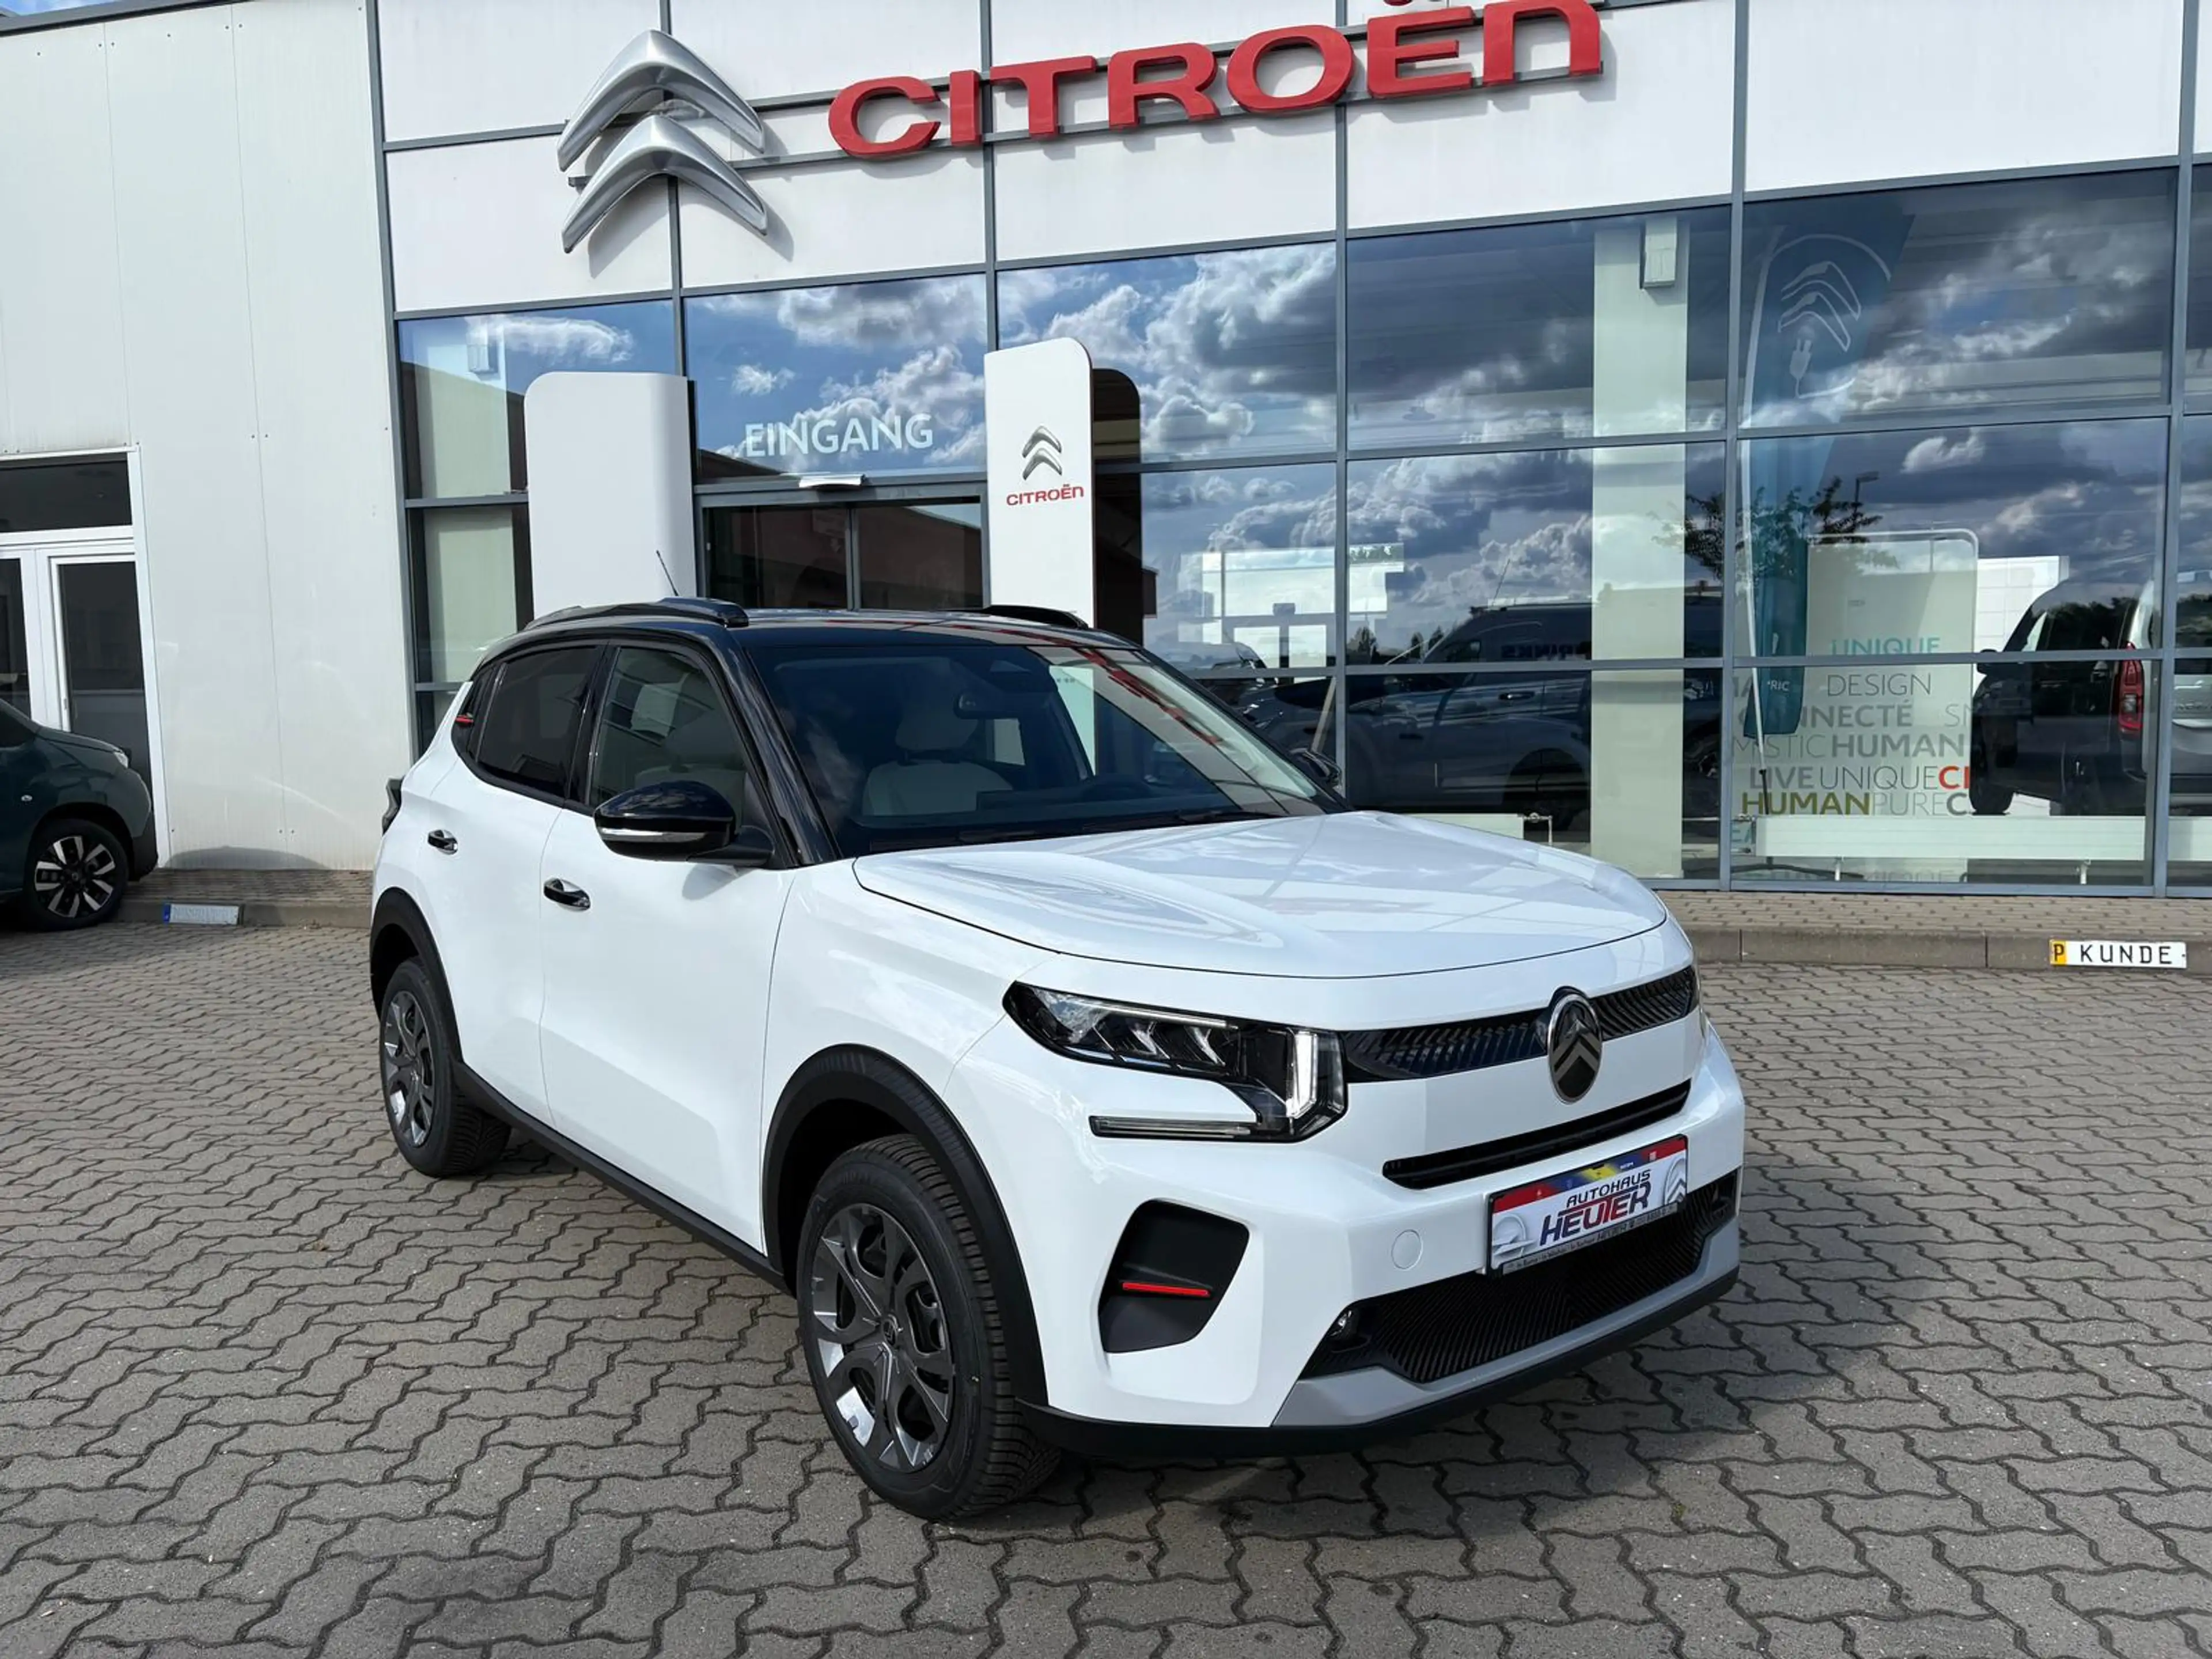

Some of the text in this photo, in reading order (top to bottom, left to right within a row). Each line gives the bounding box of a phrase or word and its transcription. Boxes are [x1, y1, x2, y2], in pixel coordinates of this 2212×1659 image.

[745, 412, 934, 457] EINGANG
[1827, 673, 1931, 696] DESIGN
[1832, 733, 1964, 758] HUMAN
[1749, 766, 1814, 790] LIVE
[1820, 765, 1938, 790] UNIQUE
[1743, 791, 1870, 816] HUMAN
[1872, 792, 1946, 816] PURE
[2054, 944, 2172, 964] P KUNDE
[1566, 1169, 1652, 1208] AUTOHAUS
